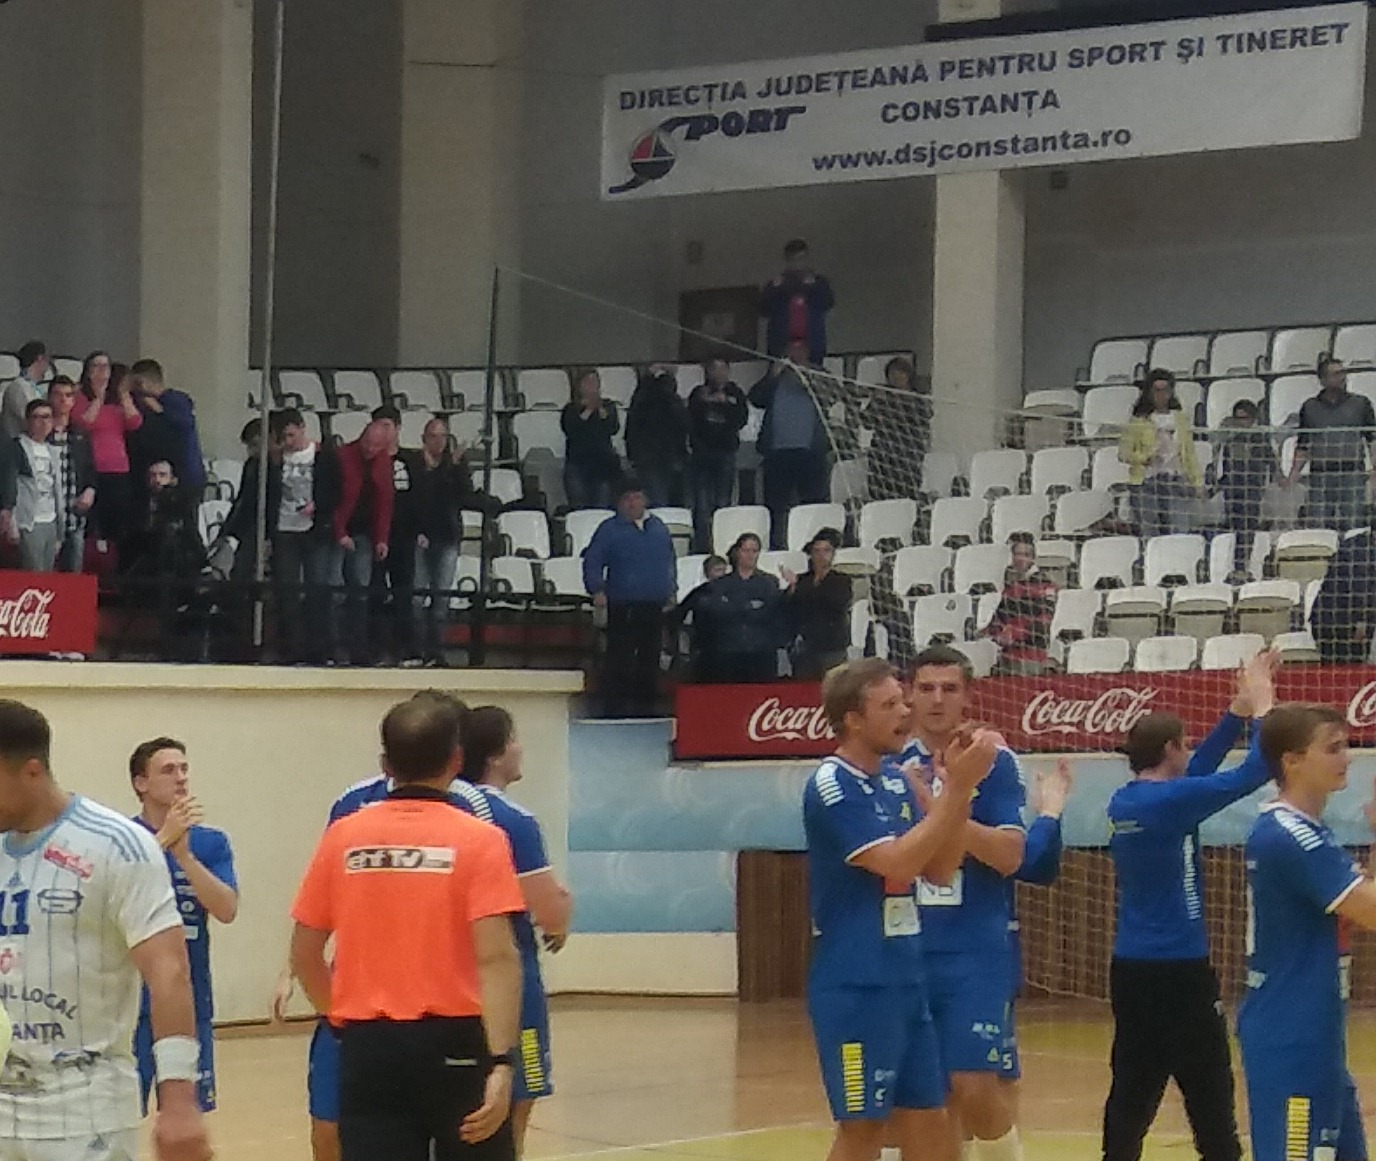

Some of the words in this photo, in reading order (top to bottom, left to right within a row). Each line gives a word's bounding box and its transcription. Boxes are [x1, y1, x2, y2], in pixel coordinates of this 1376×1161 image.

[938, 52, 1057, 81] PENTRU
[1067, 40, 1166, 69] SPORT
[1215, 23, 1350, 54] TINERET
[813, 128, 1131, 170] www.dsjconstanta.ro
[1022, 687, 1159, 735] Coca-Col
[21, 988, 78, 1019] LOCAL
